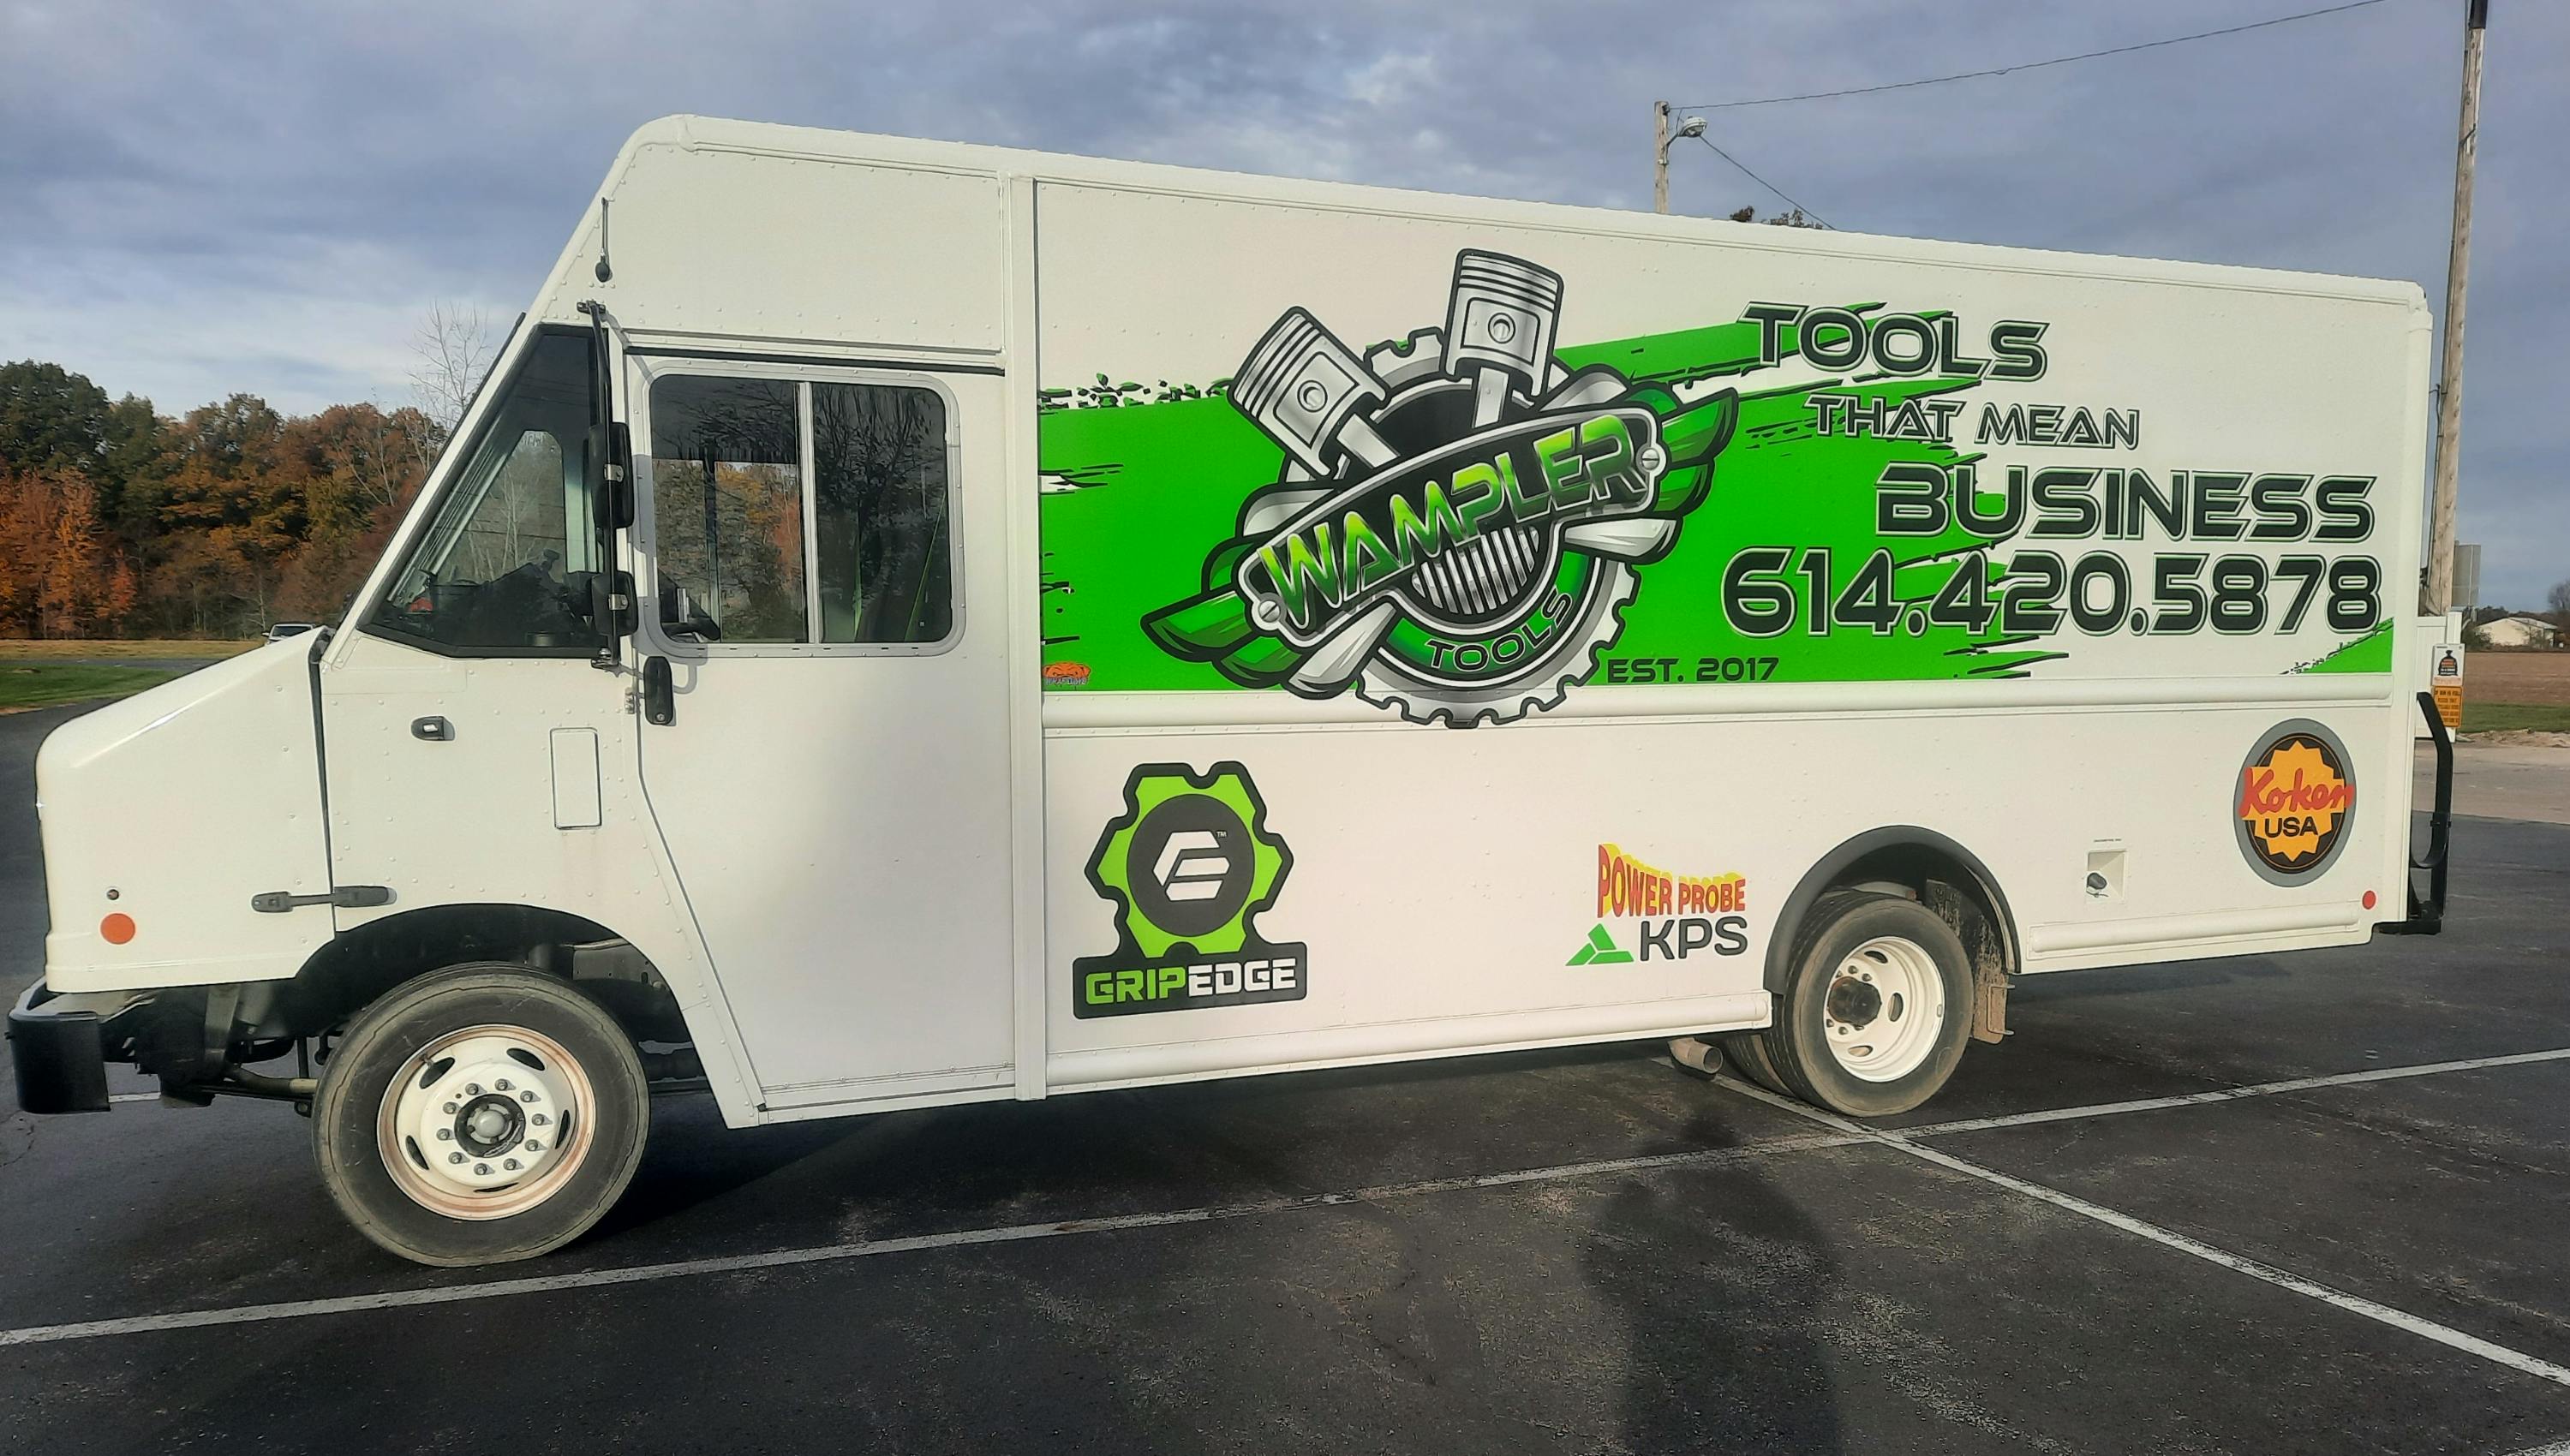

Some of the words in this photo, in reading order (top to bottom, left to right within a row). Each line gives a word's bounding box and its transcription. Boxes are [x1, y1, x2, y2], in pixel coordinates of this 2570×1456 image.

[1736, 301, 2050, 382] TOOLS
[1802, 393, 1967, 444] THAT
[1974, 402, 2139, 450] MEAN
[1257, 415, 1647, 630] WAMPLER
[1874, 461, 2377, 544] BUSINESS
[1425, 588, 1573, 671] TOOLS
[1720, 545, 2382, 639] 614.420.5878
[1607, 659, 1684, 683] EST.
[1696, 656, 1779, 681] 2017
[2238, 767, 2355, 818] Koken
[2264, 817, 2318, 838] USA
[1597, 843, 1673, 918] POWER
[1678, 874, 1746, 915] PROBE
[1641, 916, 1748, 961] KPS
